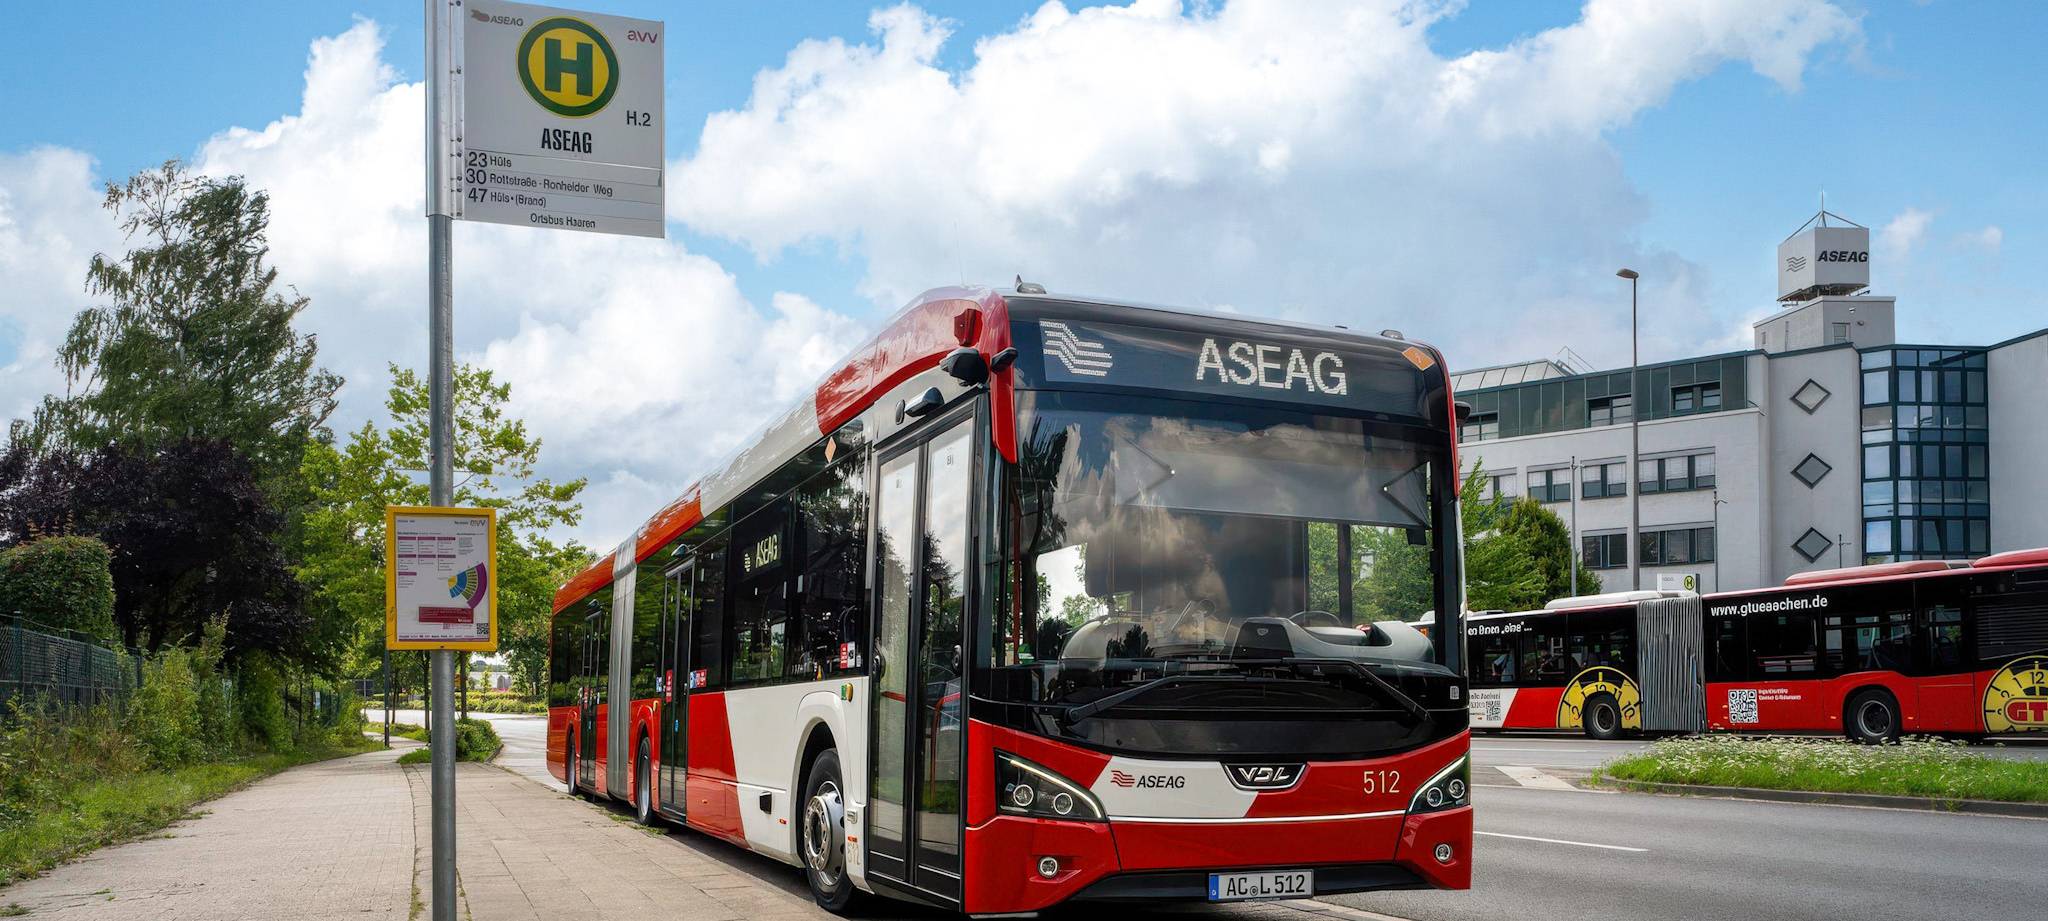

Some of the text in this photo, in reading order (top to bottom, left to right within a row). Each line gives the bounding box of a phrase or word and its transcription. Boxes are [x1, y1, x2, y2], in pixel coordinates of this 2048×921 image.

[490, 15, 524, 27] ASEAG
[627, 30, 658, 44] avv
[544, 37, 593, 97] H
[626, 110, 651, 127] H.2
[541, 128, 592, 154] ASEAG
[468, 151, 512, 168] 23 Hüls
[466, 168, 487, 184] 30
[468, 187, 488, 204] 47
[1817, 250, 1869, 262] ASEAG
[1196, 338, 1348, 396] ASEAG
[755, 534, 778, 568] ASEAG
[1711, 594, 1828, 617] www.gtueaachen.de
[2030, 671, 2045, 684] 12
[1136, 767, 1290, 789] ASEAG VDL
[1363, 770, 1400, 794] 512
[1226, 877, 1248, 896] AC
[1260, 876, 1270, 894] L
[1275, 874, 1305, 894] 512
